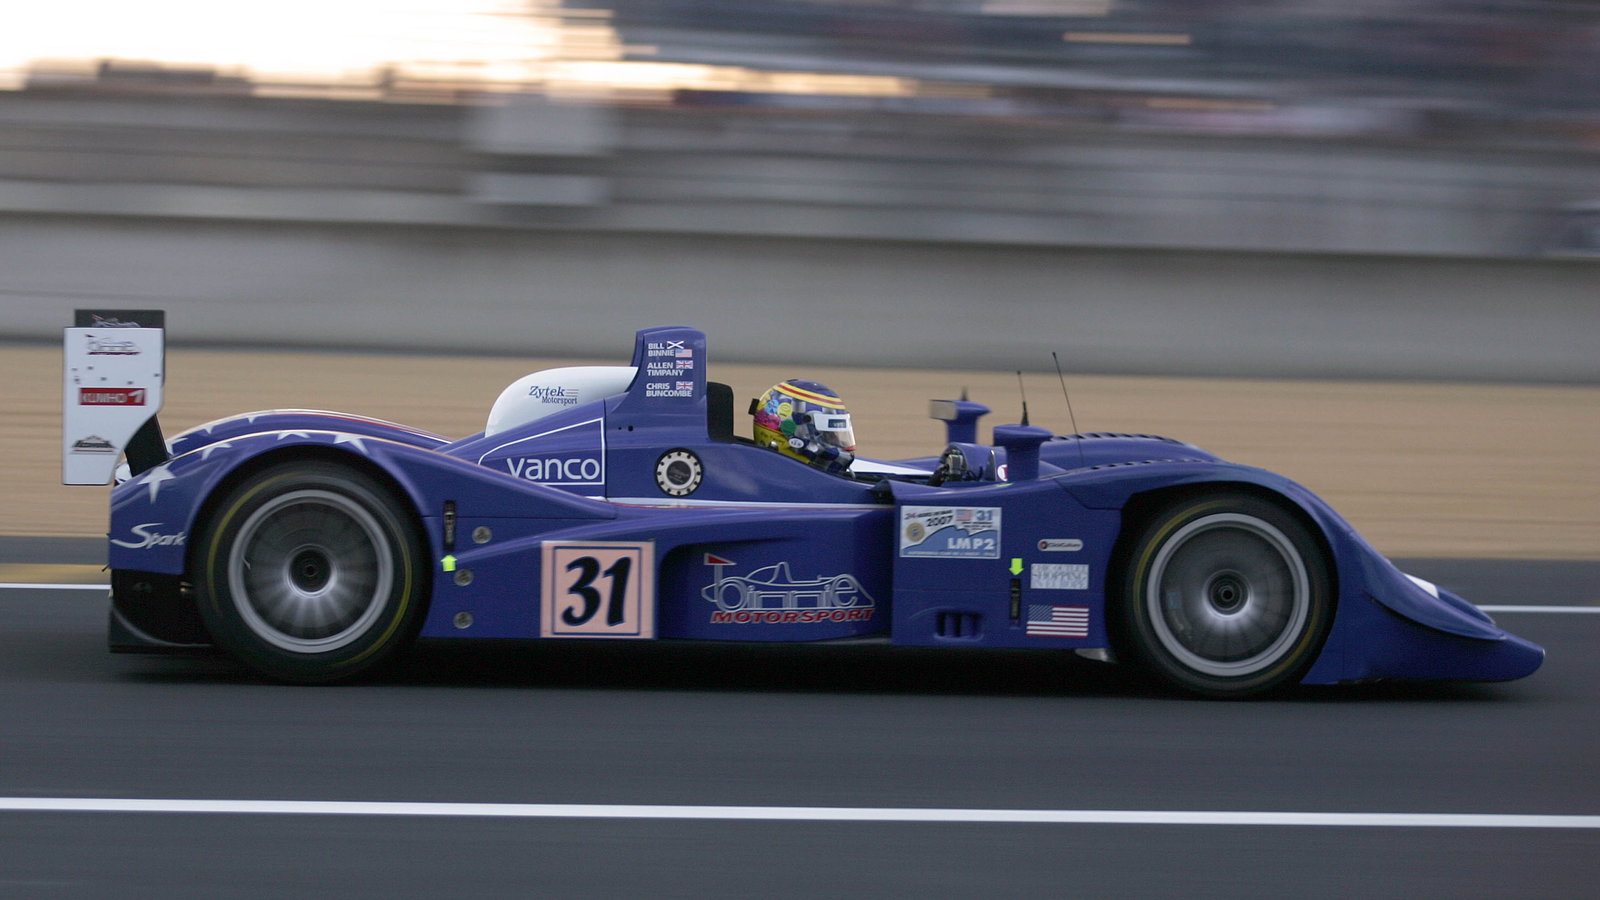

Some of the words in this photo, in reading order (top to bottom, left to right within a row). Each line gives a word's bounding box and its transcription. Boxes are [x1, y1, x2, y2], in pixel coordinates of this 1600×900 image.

[528, 385, 565, 398] Zytek
[542, 396, 577, 406] Motorsport
[507, 458, 600, 480] vanco
[926, 516, 953, 527] 2007
[975, 510, 993, 521] 31
[561, 556, 632, 627] 31
[710, 608, 876, 624] MOTORSPORT
